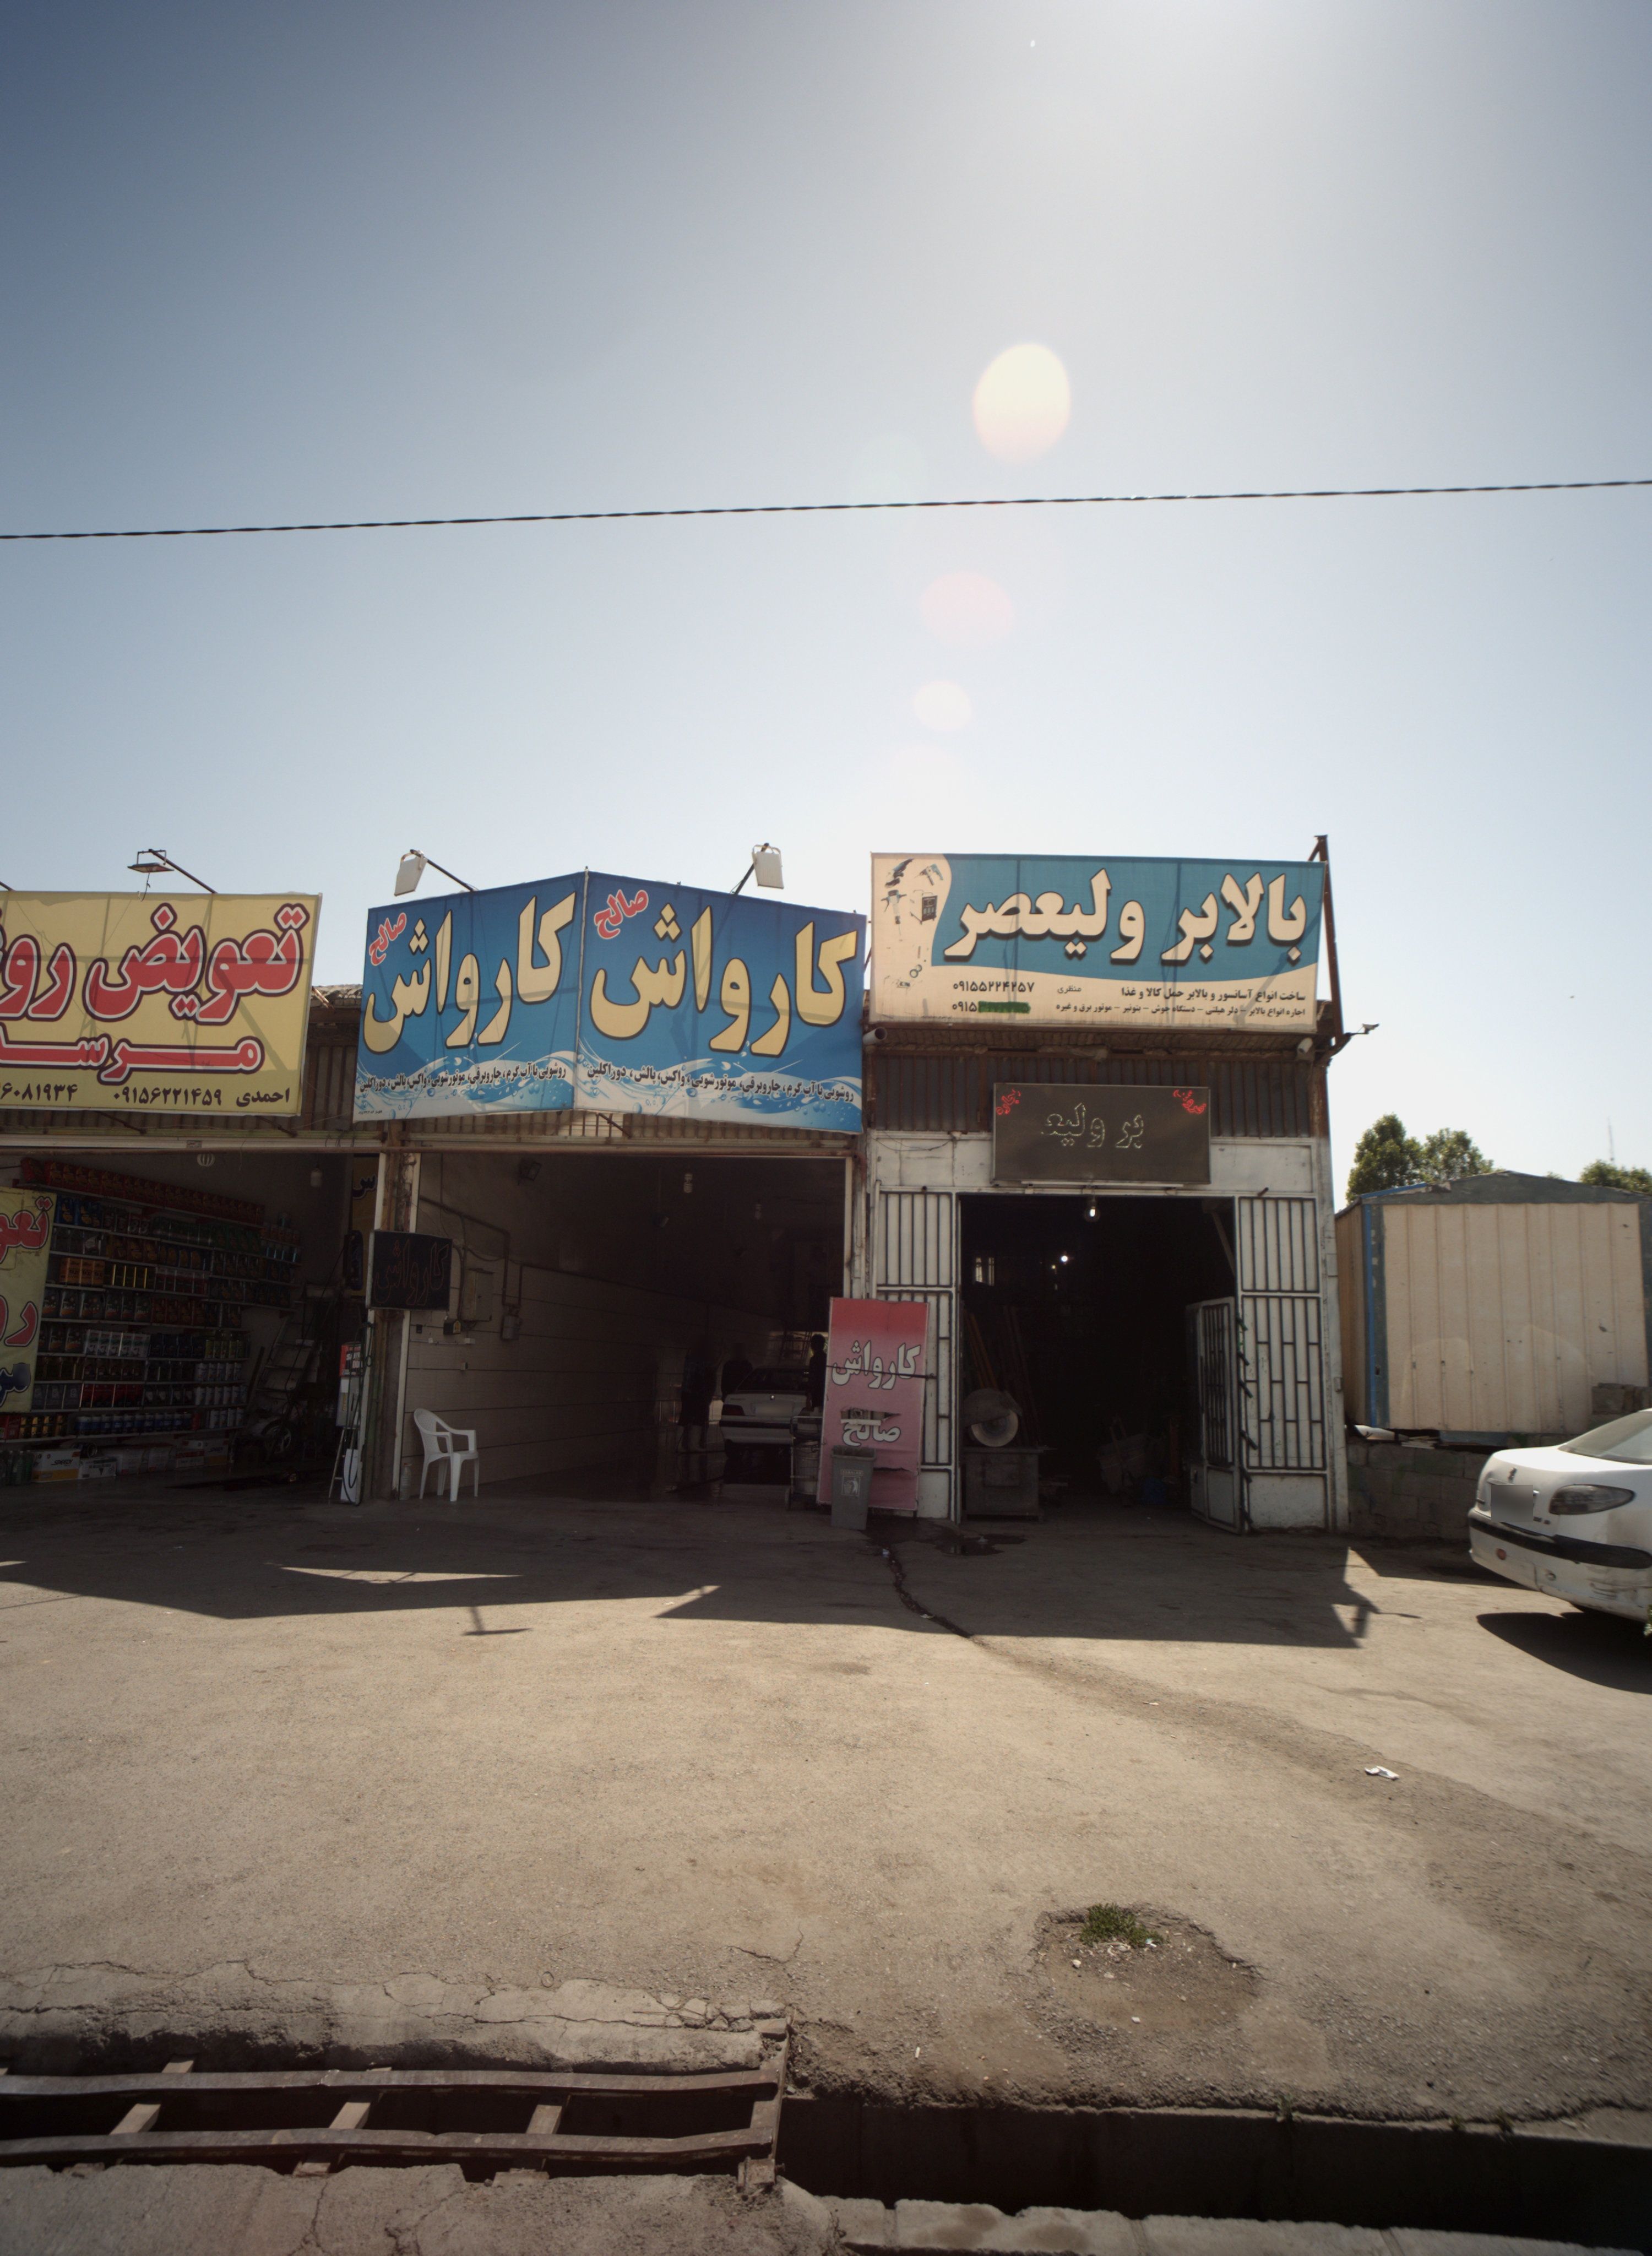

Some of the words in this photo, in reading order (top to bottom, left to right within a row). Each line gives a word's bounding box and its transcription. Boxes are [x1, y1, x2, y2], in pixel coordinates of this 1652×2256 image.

[593, 888, 650, 940] صالح
[1161, 872, 1307, 966] بالابر
[368, 910, 407, 966] صالح
[0, 906, 77, 1022] رو
[83, 902, 309, 1025] تعویض
[362, 891, 576, 1055] کارواش
[589, 902, 858, 1058] کارواش
[953, 980, 1035, 993] ۰۹۱۵۵۲۲۴۲۵۷
[1146, 987, 1162, 996] کالا
[1139, 991, 1144, 999] و
[1164, 988, 1184, 999] حمل
[1186, 989, 1208, 1001] بالابر
[1218, 989, 1253, 1001] آسانسور
[1255, 990, 1278, 1002] انواع
[1279, 991, 1306, 1001] ساخت
[1056, 1003, 1071, 1012] غیره
[1079, 1004, 1091, 1012] برق
[1093, 1004, 1112, 1013] موتور
[1151, 1004, 1170, 1014] جوش
[1172, 1005, 1195, 1013] دستگاه
[1249, 1007, 1265, 1017] بالابر
[1267, 1008, 1285, 1017] انواع
[1286, 1008, 1306, 1018] اجاره
[0, 1022, 265, 1085] مرس
[113, 1086, 222, 1107] ۰۹۱۵۶۲۲۱۴۵۹
[236, 1088, 290, 1107] احمدی
[831, 1340, 922, 1391] کارواش
